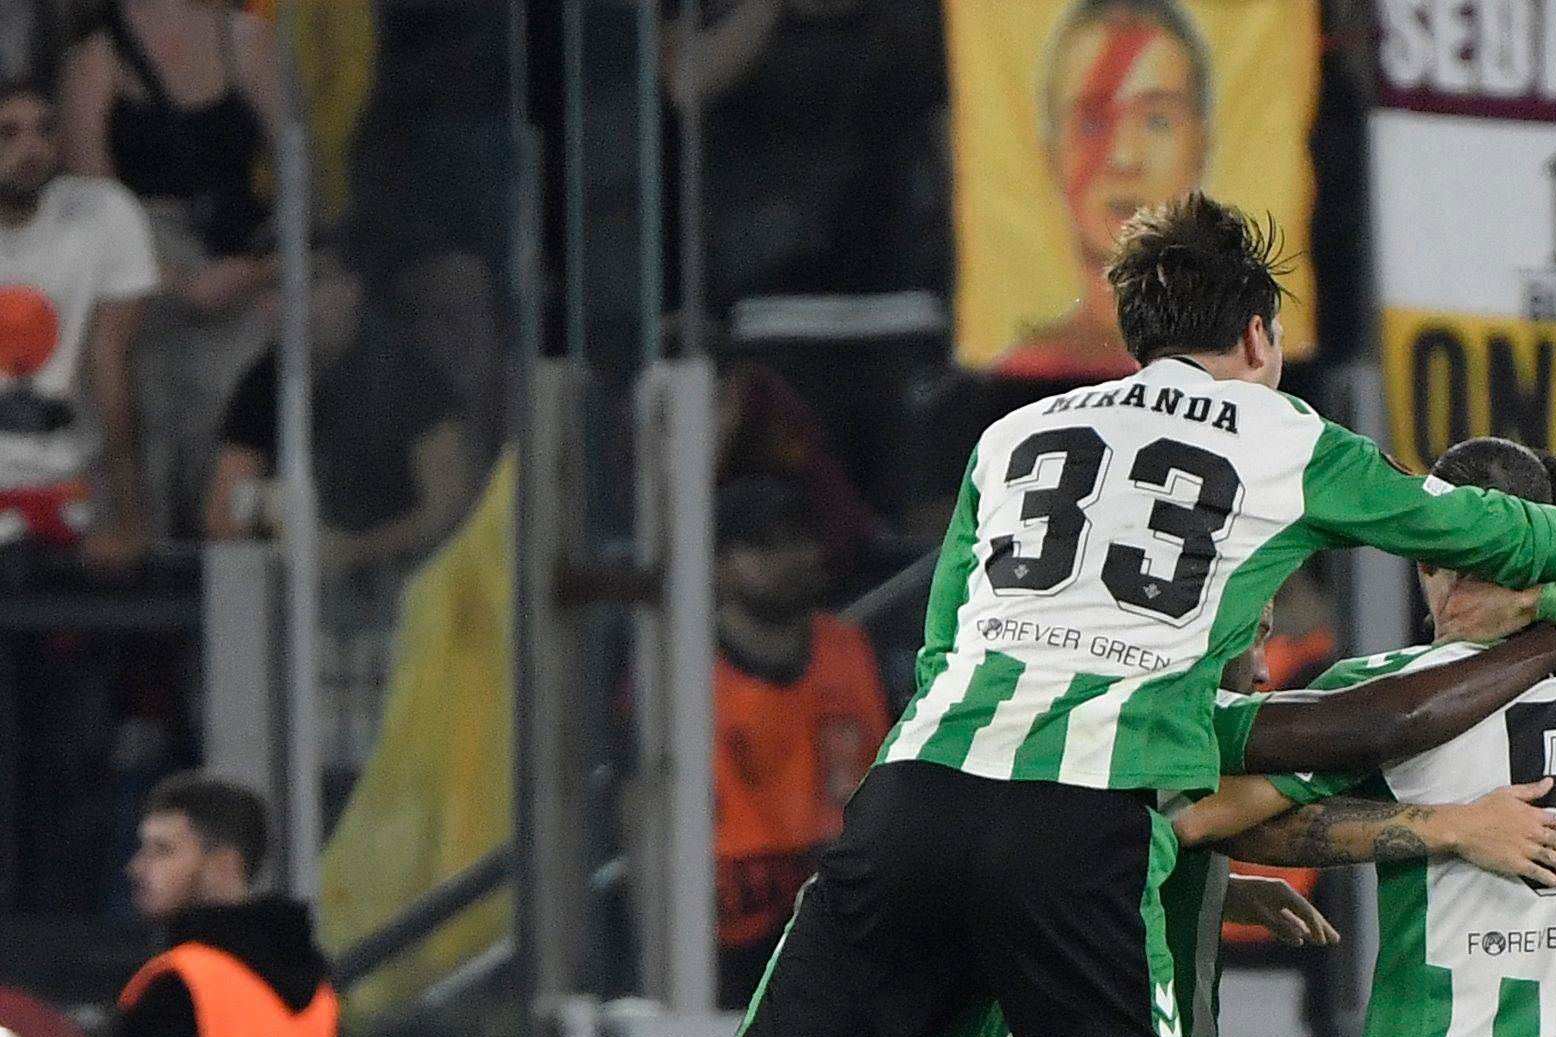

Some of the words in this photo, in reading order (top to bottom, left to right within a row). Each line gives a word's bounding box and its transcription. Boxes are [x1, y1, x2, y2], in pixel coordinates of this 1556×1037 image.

[1042, 383, 1239, 434] MIRANDA
[1411, 328, 1556, 476] ON
[985, 425, 1246, 629] 33
[1090, 636, 1171, 673] GREEN
